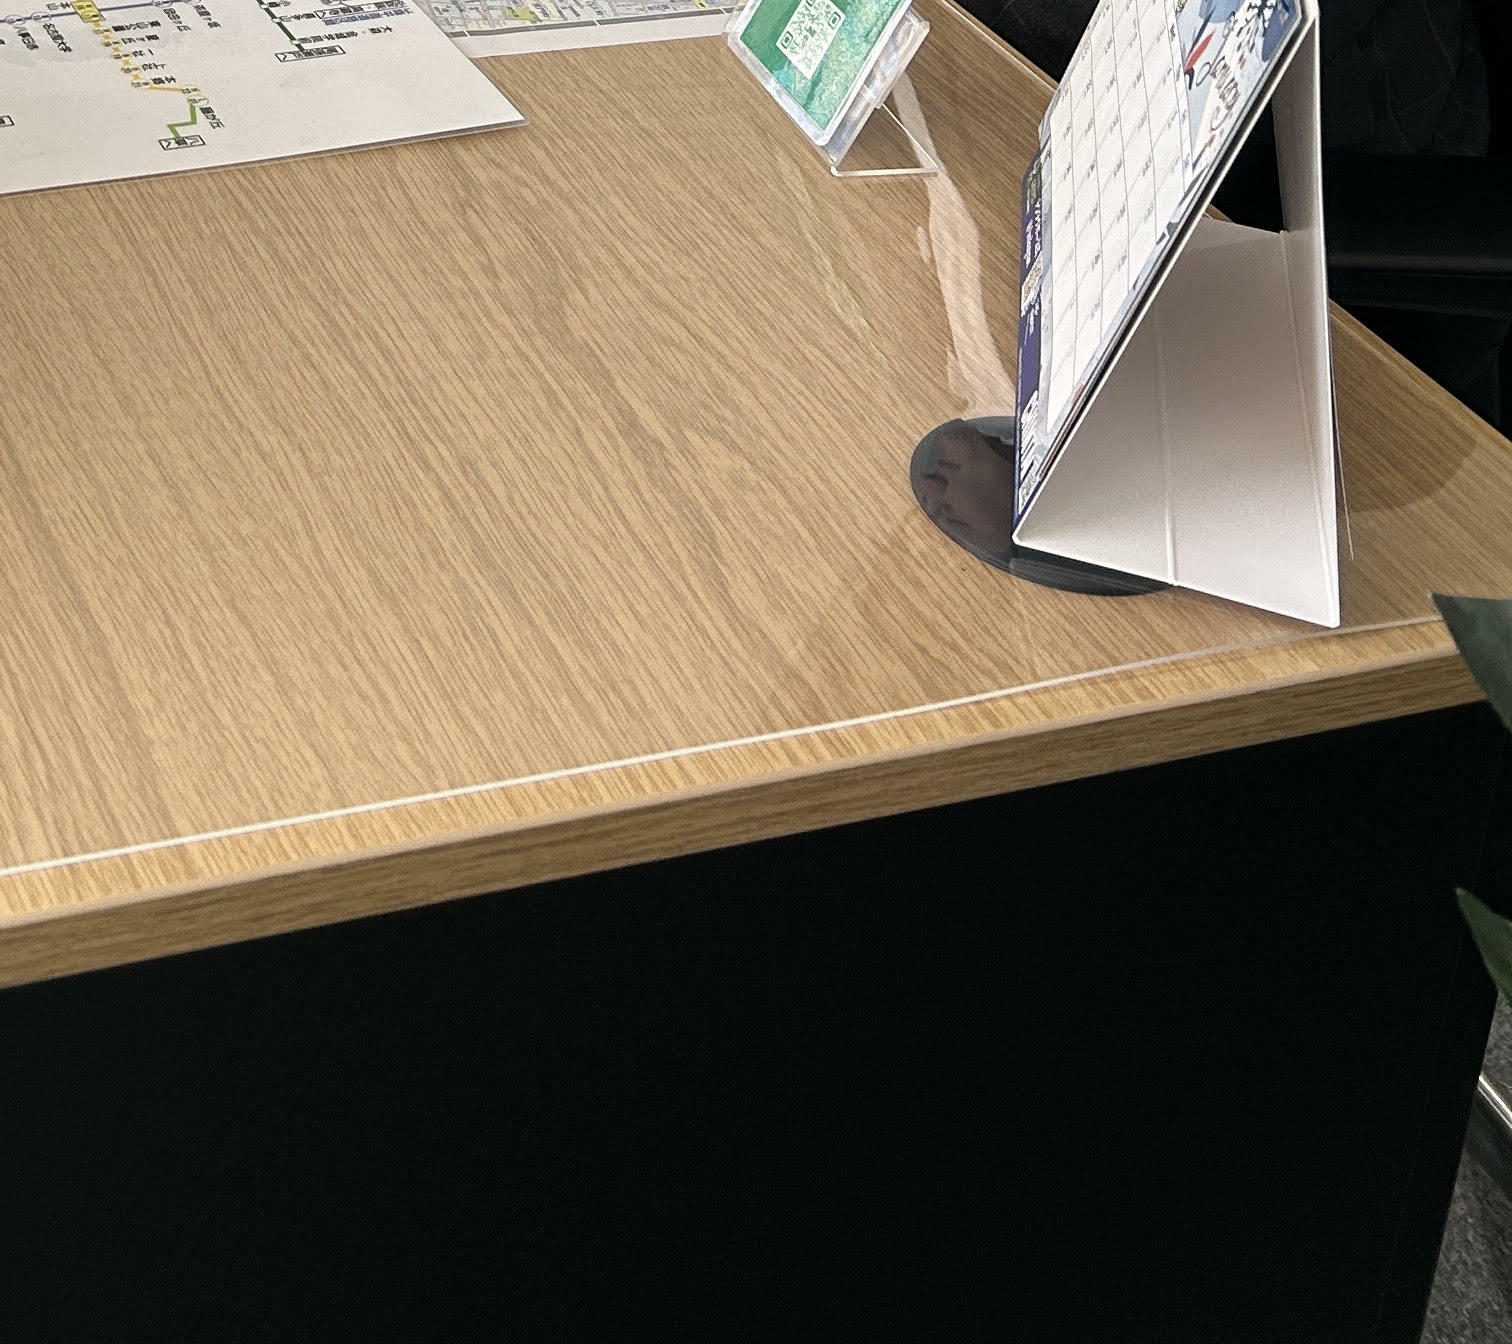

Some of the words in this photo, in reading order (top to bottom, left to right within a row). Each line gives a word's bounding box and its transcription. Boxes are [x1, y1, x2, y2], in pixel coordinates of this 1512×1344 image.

[13, 24, 40, 50] 八事日赤
[40, 22, 73, 53] 名古屋大学
